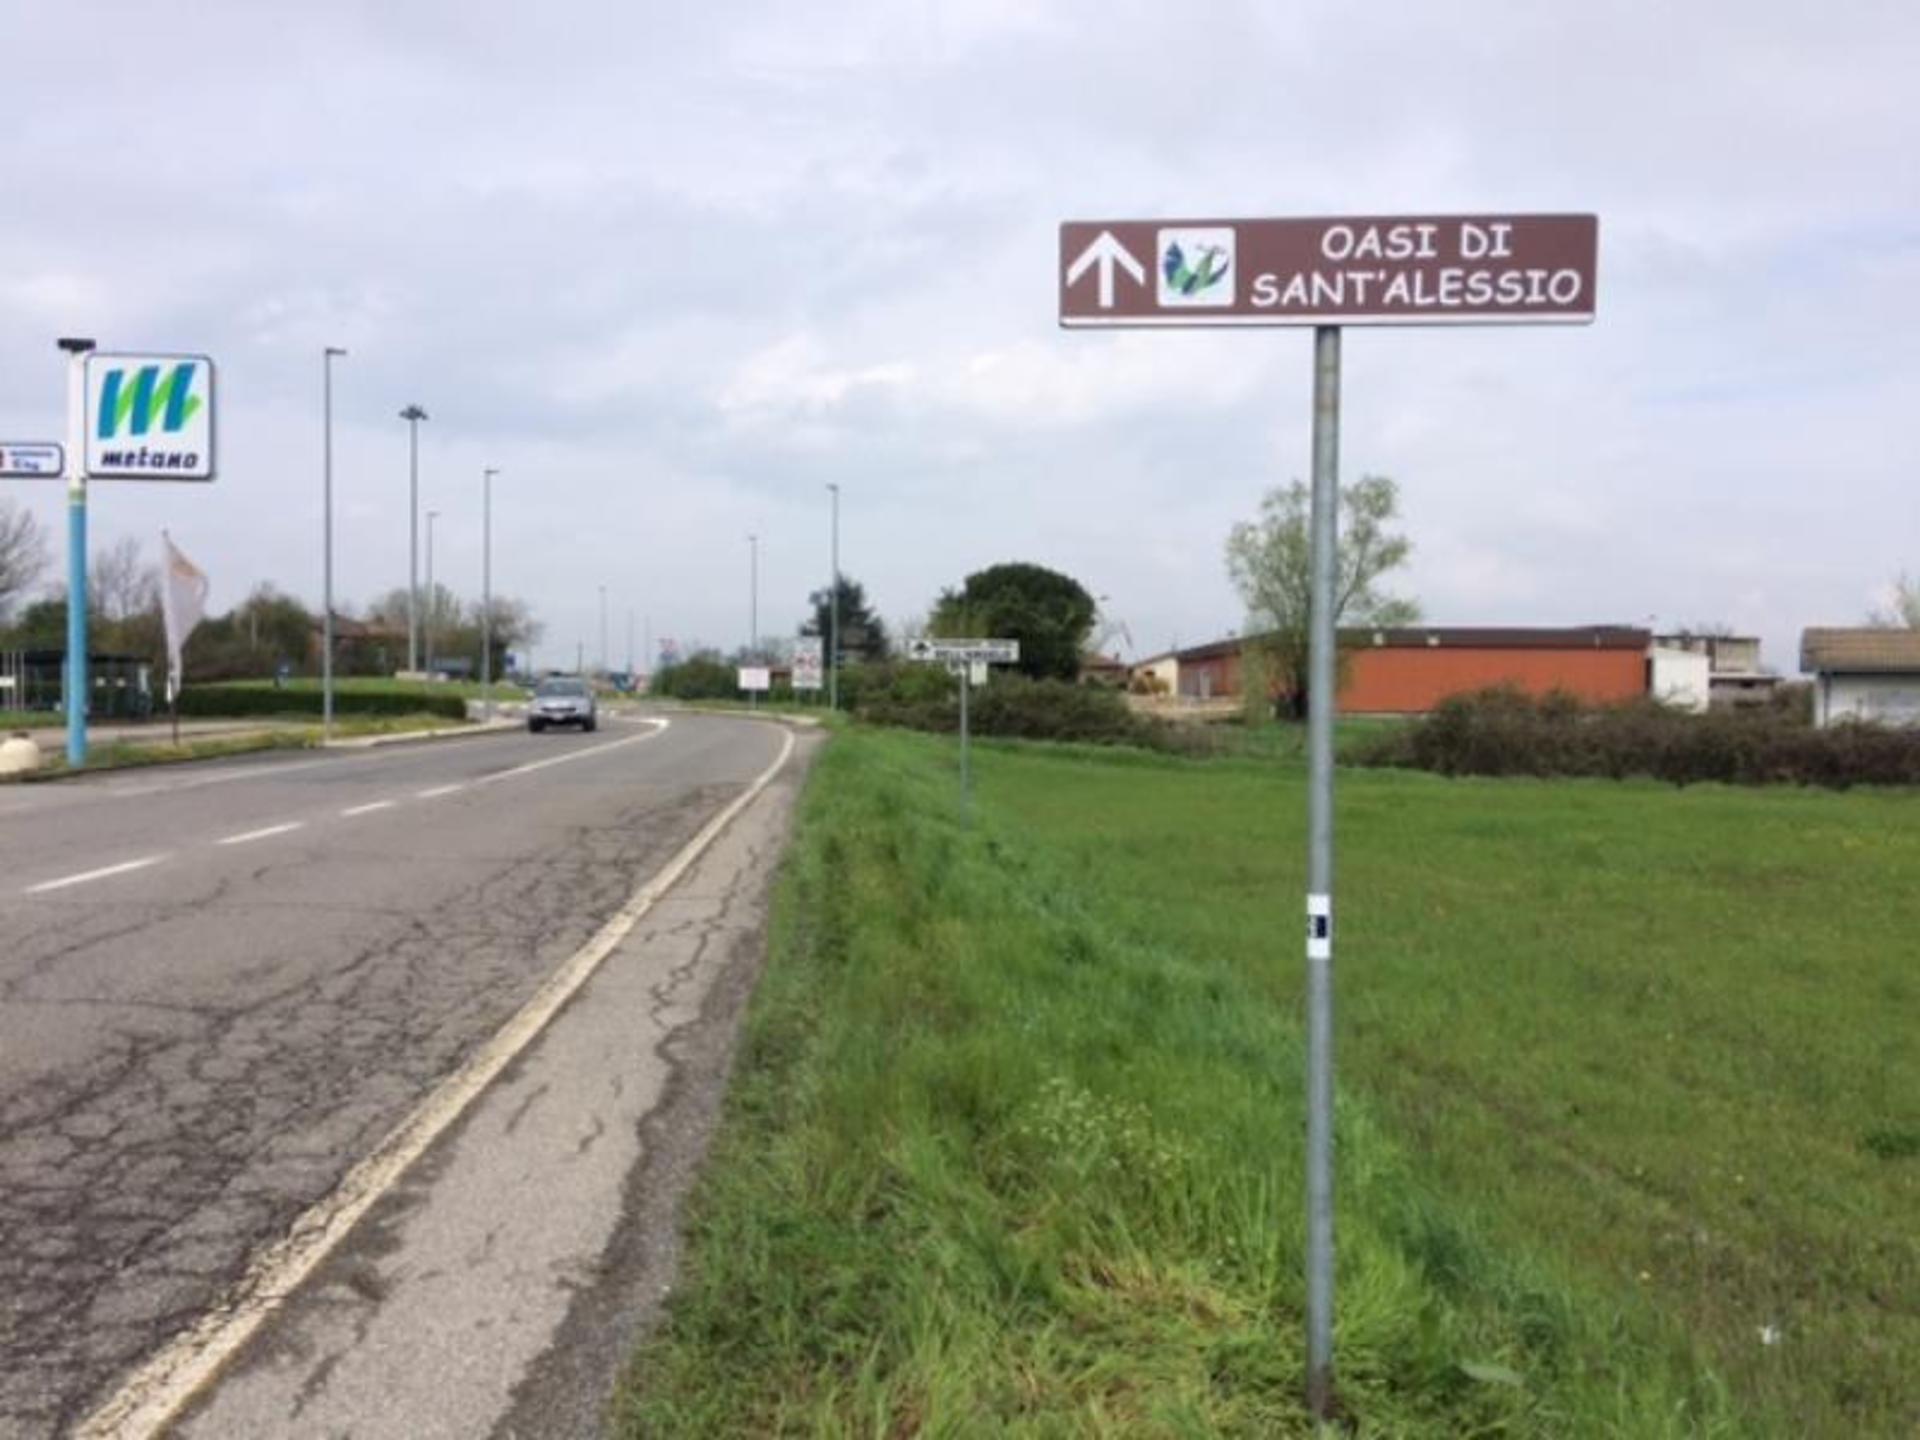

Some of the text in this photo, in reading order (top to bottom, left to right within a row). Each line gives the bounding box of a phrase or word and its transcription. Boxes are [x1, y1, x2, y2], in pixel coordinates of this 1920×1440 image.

[1321, 223, 1513, 261] OASI DI
[1251, 268, 1582, 307] SANT'ALESSIO
[101, 447, 199, 469] metano
